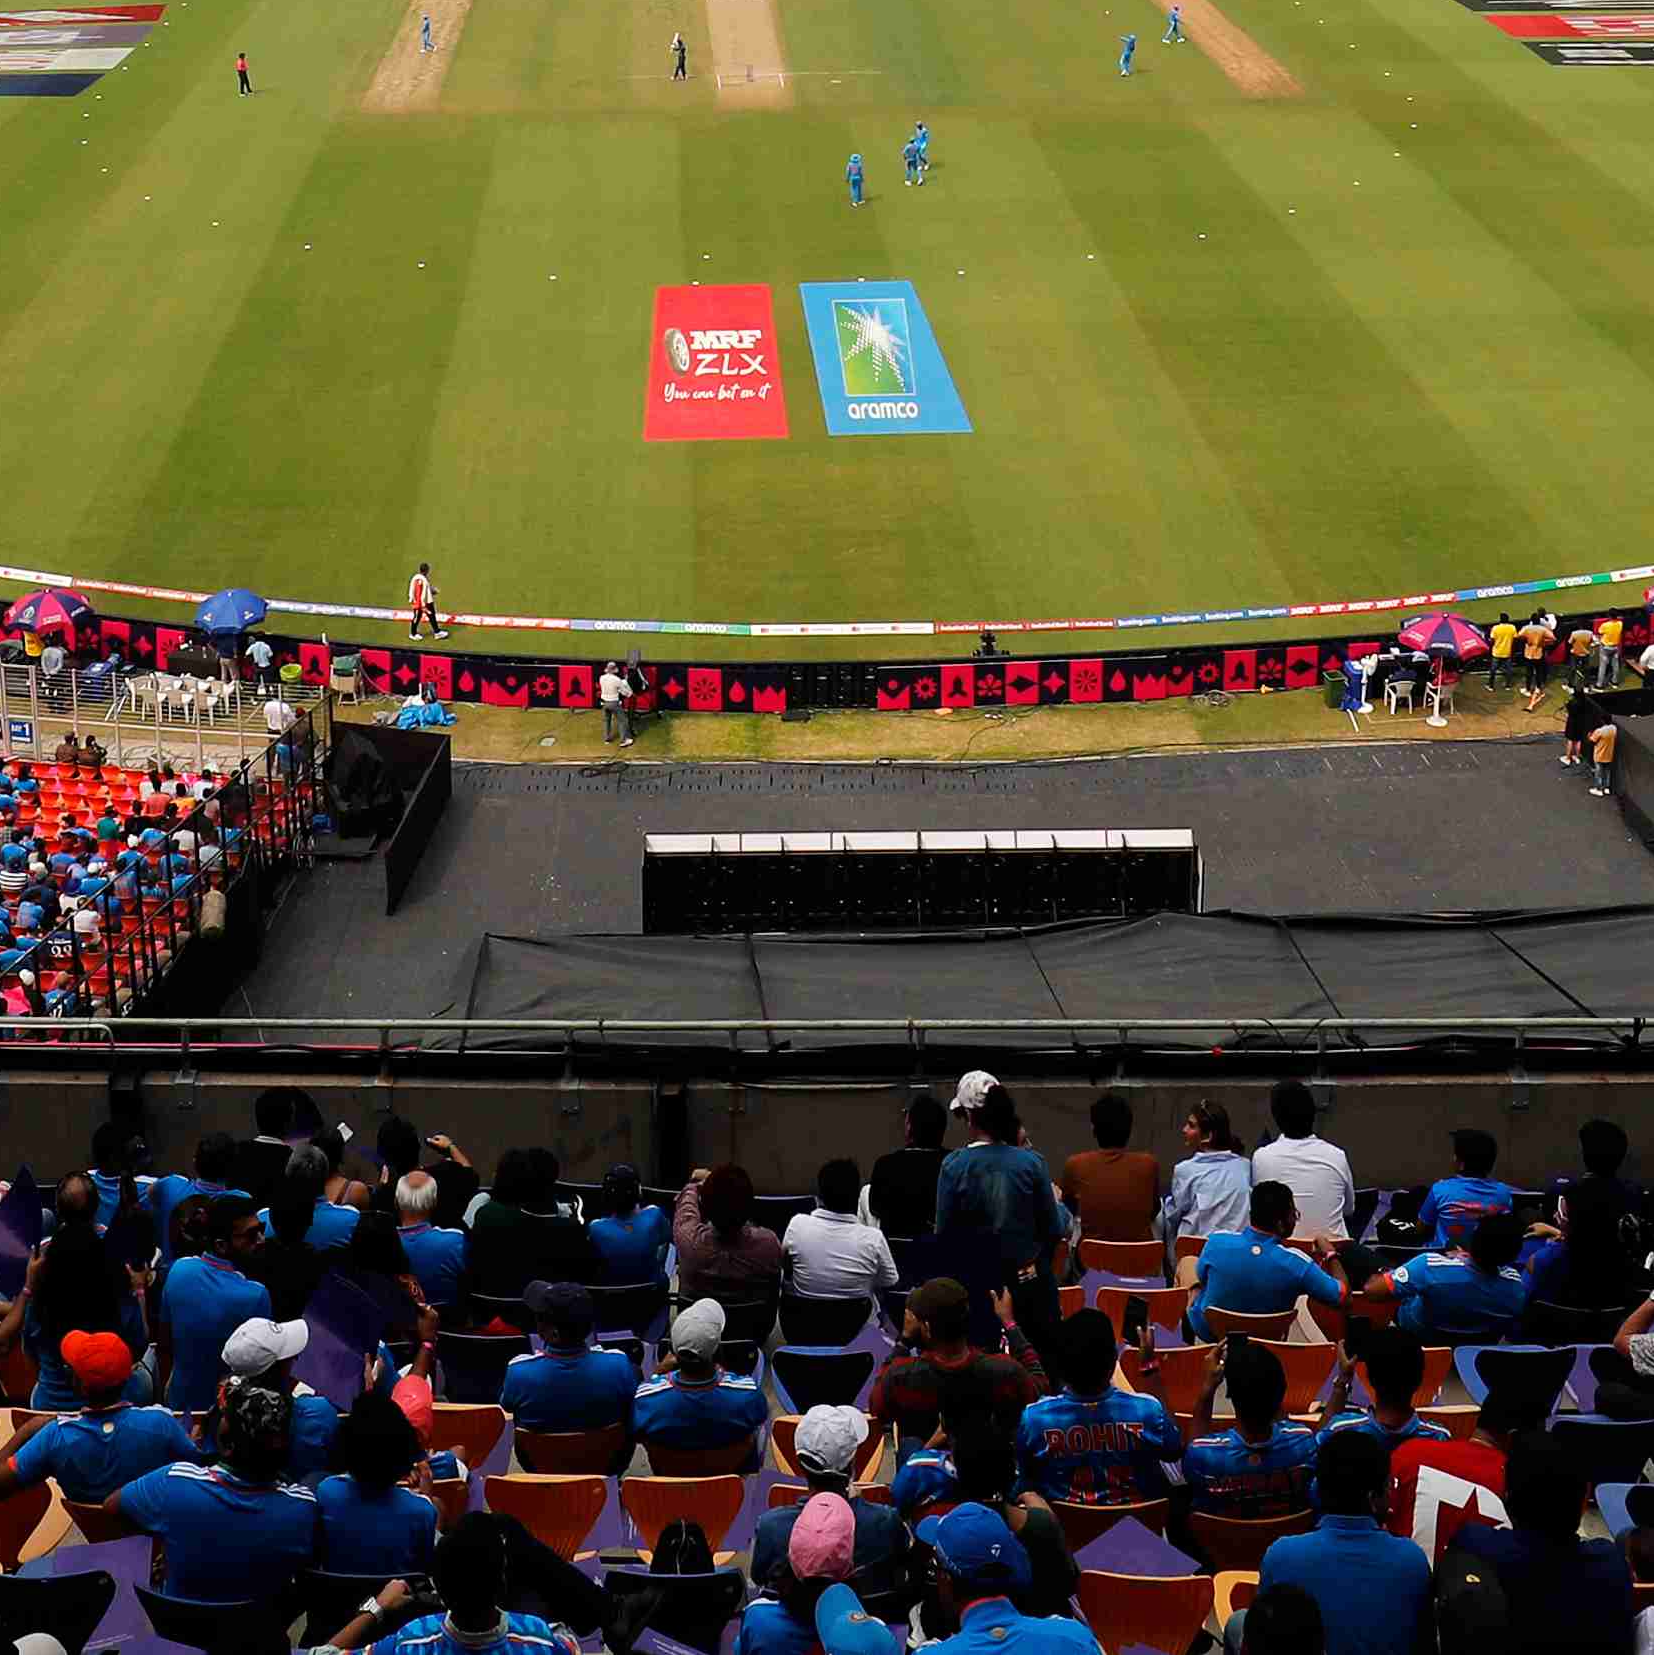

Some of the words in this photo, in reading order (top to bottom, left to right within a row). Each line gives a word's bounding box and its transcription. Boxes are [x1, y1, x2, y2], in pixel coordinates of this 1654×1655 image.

[690, 329, 762, 350] MRF
[695, 353, 768, 376] ZLX
[663, 382, 691, 403] You
[692, 388, 714, 401] can
[717, 382, 739, 402] bet
[738, 388, 757, 400] on
[758, 383, 773, 401] it
[847, 402, 919, 420] aramco
[1556, 575, 1593, 588] aramco
[1477, 585, 1514, 598] aramco
[1403, 597, 1428, 606] MRF
[1431, 593, 1456, 603] MRF
[1319, 605, 1344, 614] MRF
[1348, 603, 1373, 612] MRF
[1376, 600, 1401, 610] MRF
[1290, 607, 1317, 616] MRF
[594, 619, 636, 631] aramco
[685, 622, 728, 634] aramco
[1045, 1421, 1144, 1457] ROHIT
